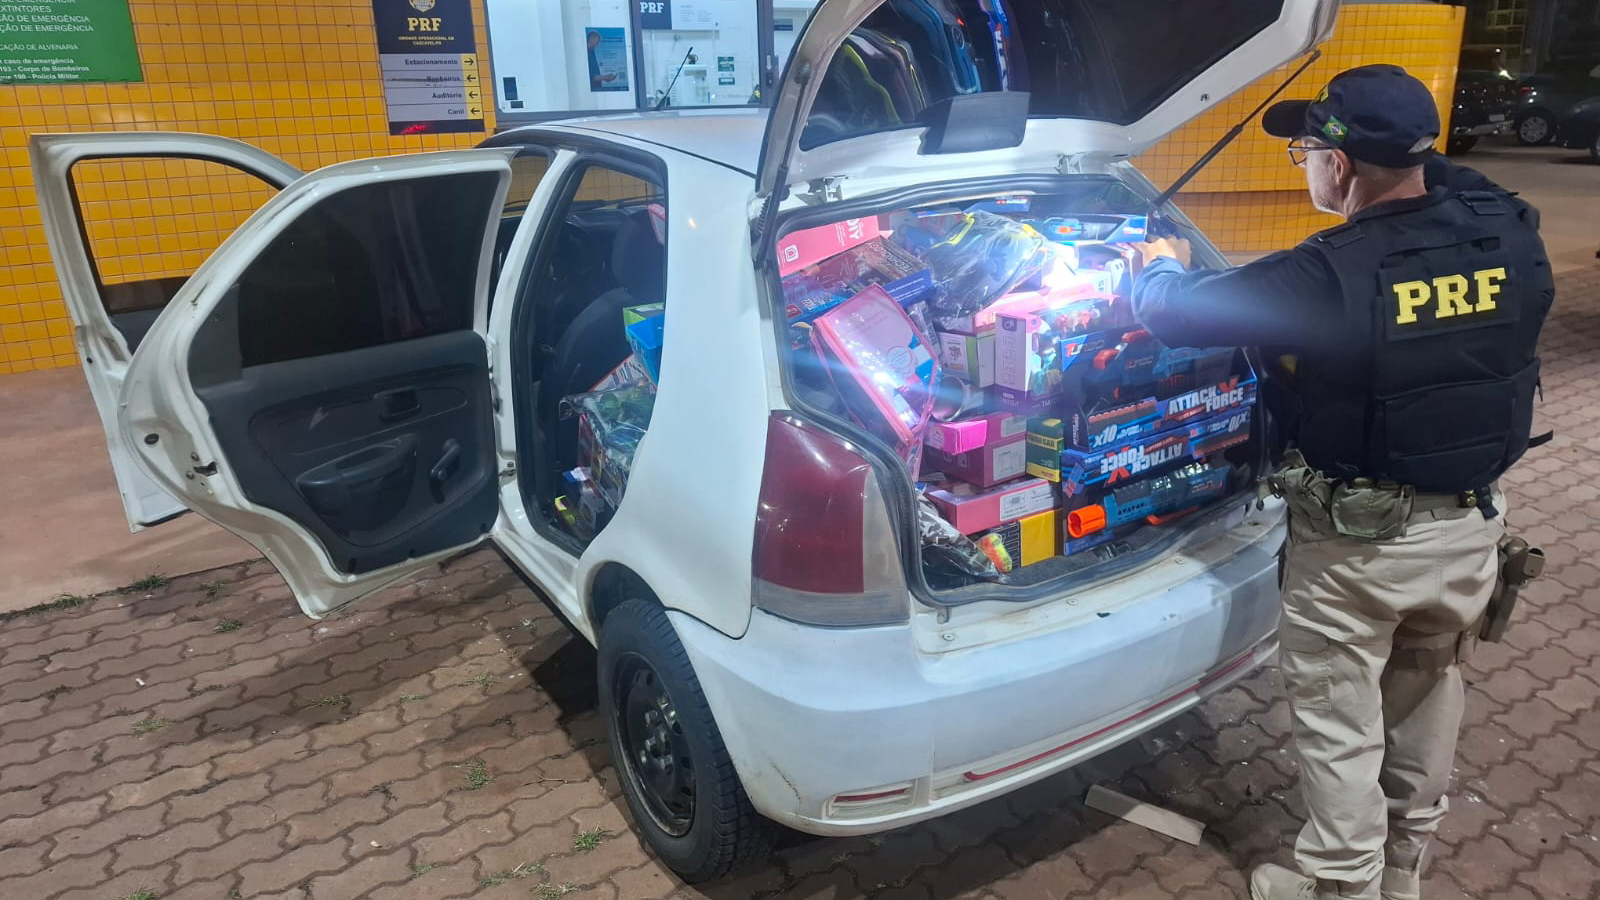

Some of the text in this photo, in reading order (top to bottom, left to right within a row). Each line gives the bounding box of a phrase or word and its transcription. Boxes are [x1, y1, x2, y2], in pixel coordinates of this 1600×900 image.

[0, 5, 52, 13] XTINTORES
[640, 2, 665, 13] PRF
[20, 24, 33, 32] DE
[35, 23, 94, 32] EMERGÊNCIA
[31, 14, 90, 23] EMERGÊNCIA
[408, 17, 442, 31] PRF
[1392, 267, 1507, 325] PRF
[1168, 385, 1217, 415] ATTACK
[1205, 387, 1244, 413] FORCE
[1100, 445, 1145, 475] FORCE
[1131, 442, 1183, 474] ATTACK
